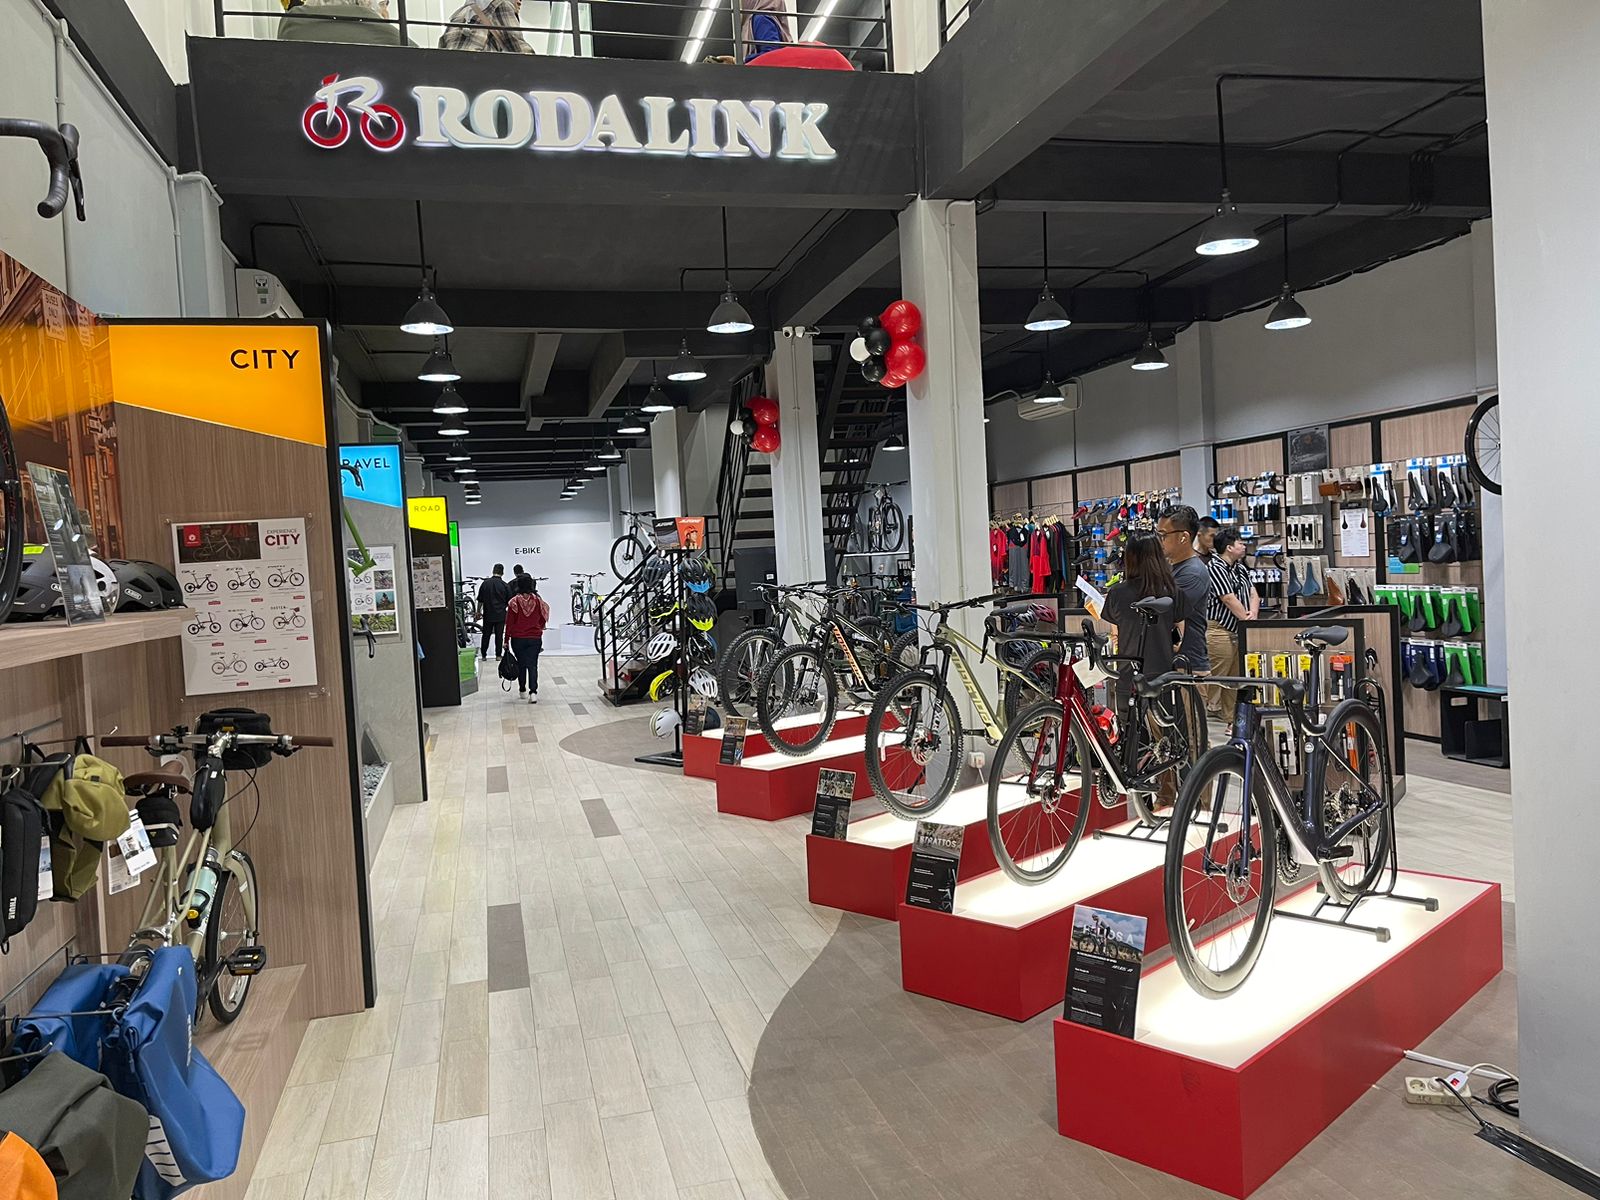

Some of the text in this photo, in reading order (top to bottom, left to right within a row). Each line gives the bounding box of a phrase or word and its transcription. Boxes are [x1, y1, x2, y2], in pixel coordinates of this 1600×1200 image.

[412, 85, 837, 160] RODALINK
[230, 349, 300, 369] CITY
[264, 533, 300, 546] CITY
[514, 547, 541, 555] E-BIKE
[8, 897, 17, 920] THULE
[1125, 933, 1135, 945] A
